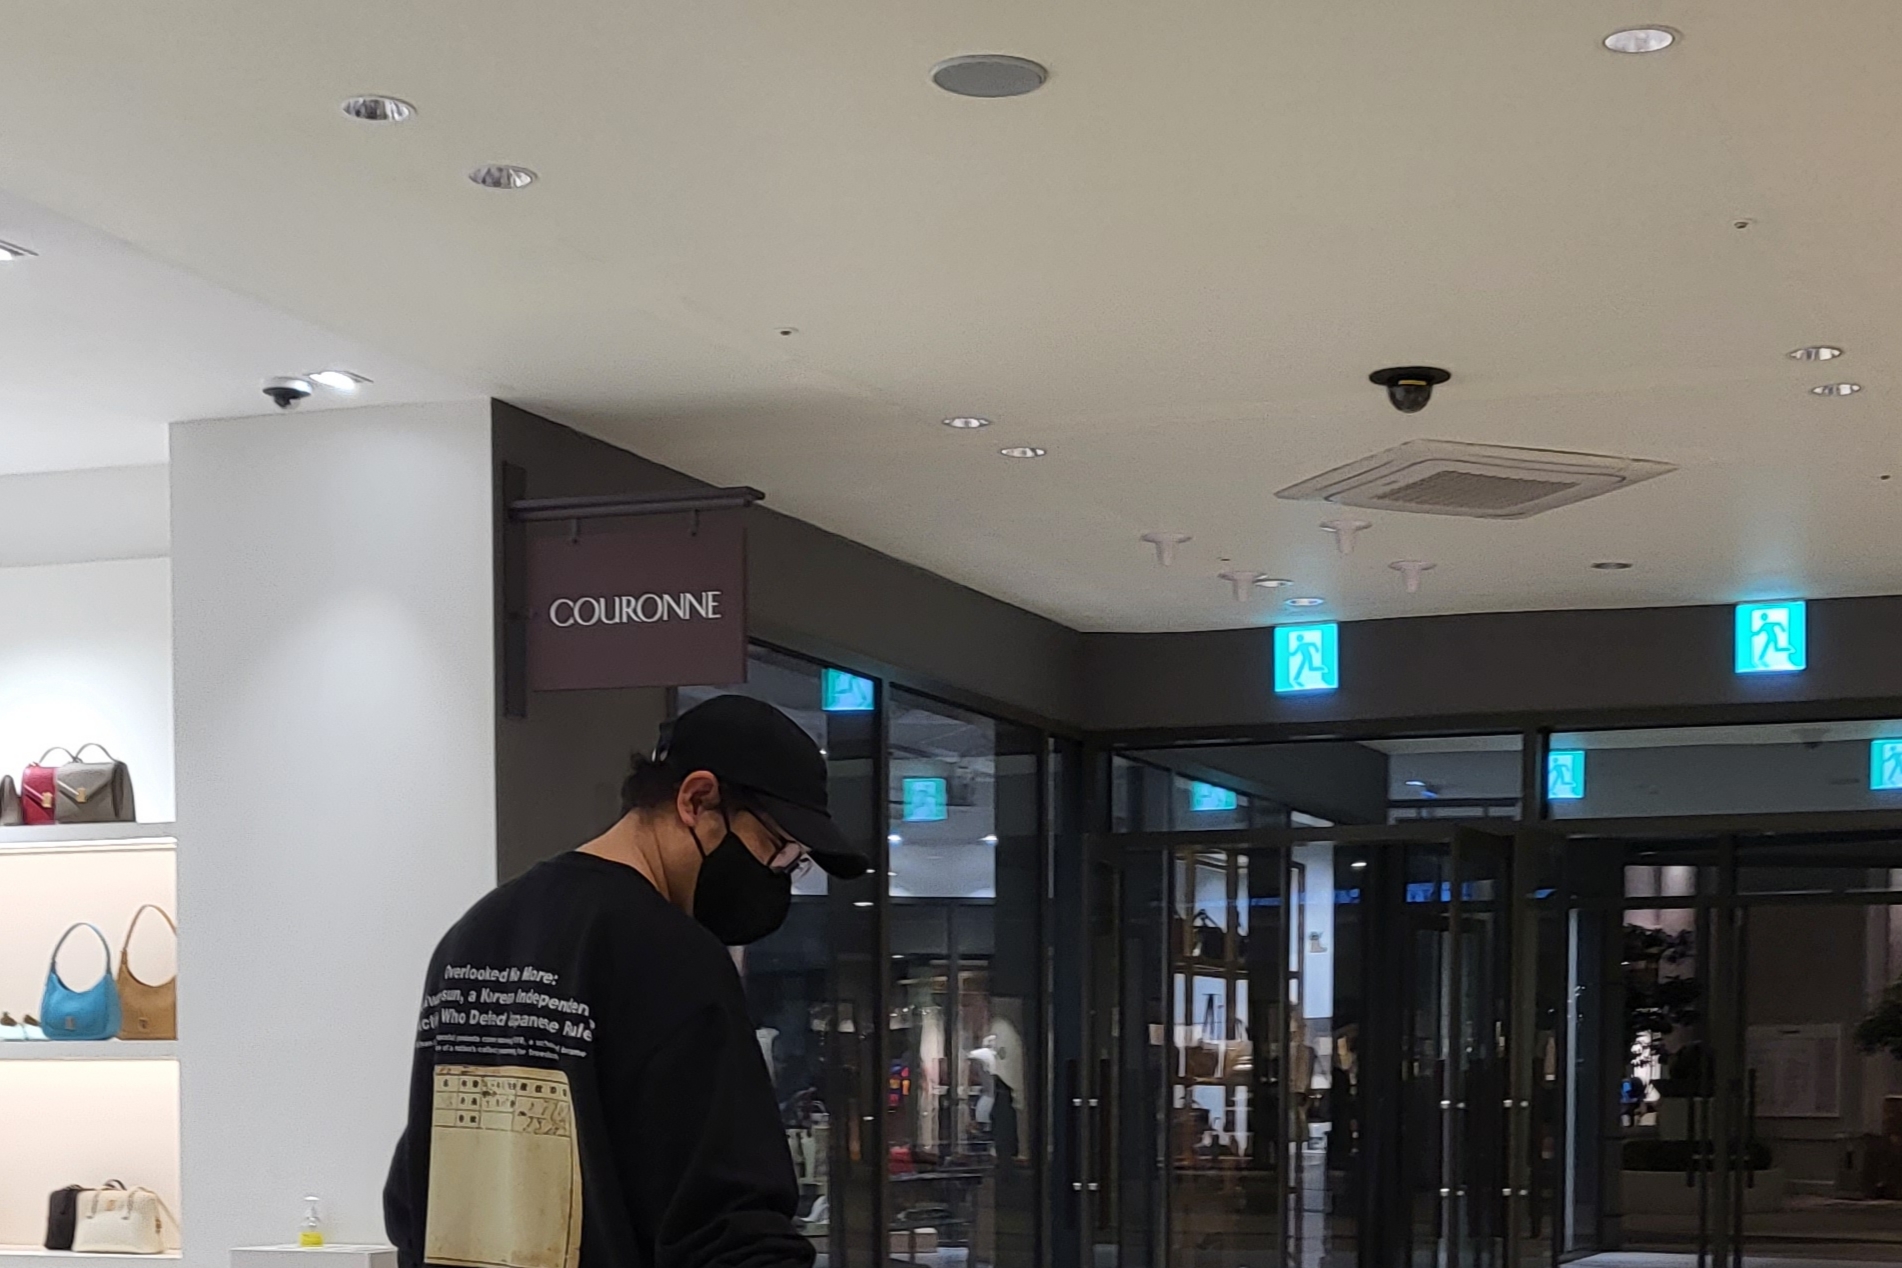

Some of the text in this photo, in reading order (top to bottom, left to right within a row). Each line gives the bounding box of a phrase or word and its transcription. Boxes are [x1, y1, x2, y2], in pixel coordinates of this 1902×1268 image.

[549, 591, 722, 627] COURONNE
[468, 990, 477, 1002] a
[441, 1007, 466, 1025] Who
[562, 1020, 593, 1042] Rule
